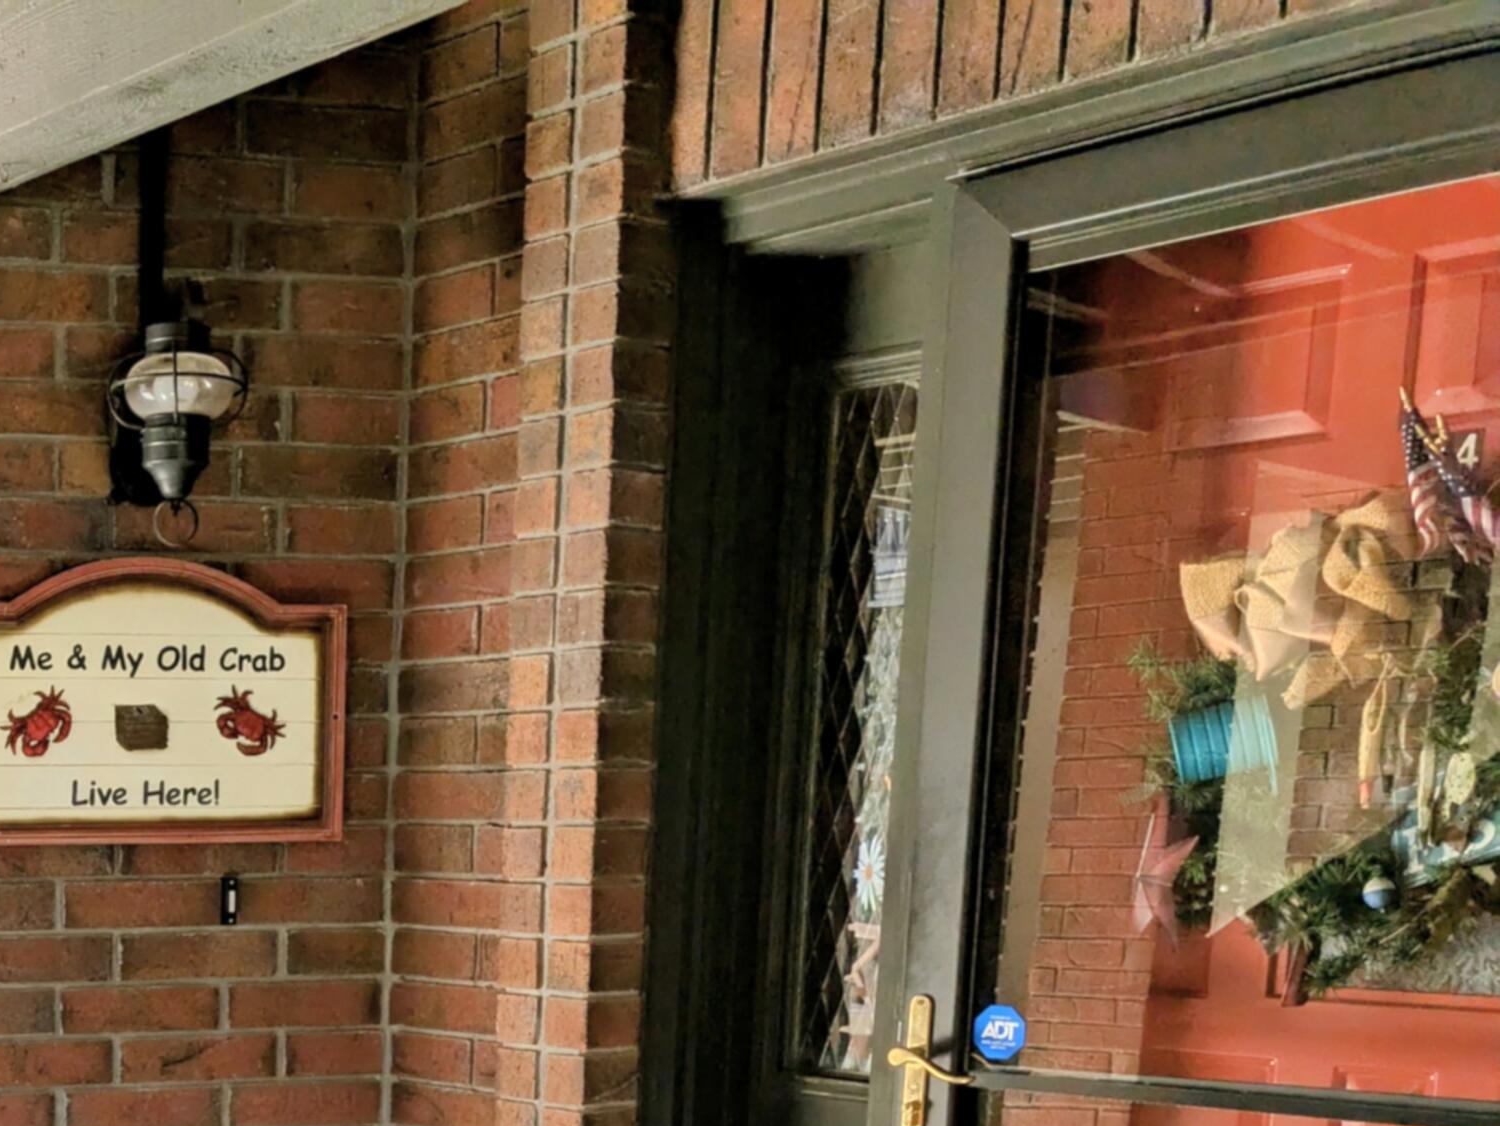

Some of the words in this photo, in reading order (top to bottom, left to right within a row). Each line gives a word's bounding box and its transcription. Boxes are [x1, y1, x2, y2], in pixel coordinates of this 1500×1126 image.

[1456, 432, 1479, 469] 4
[9, 645, 53, 671] Me
[67, 644, 87, 670] &
[101, 645, 144, 678] My
[157, 644, 206, 672] Old
[219, 646, 286, 673] Crab
[71, 780, 127, 806] Live
[143, 779, 220, 806] Here!
[981, 1020, 1019, 1041] ADT
